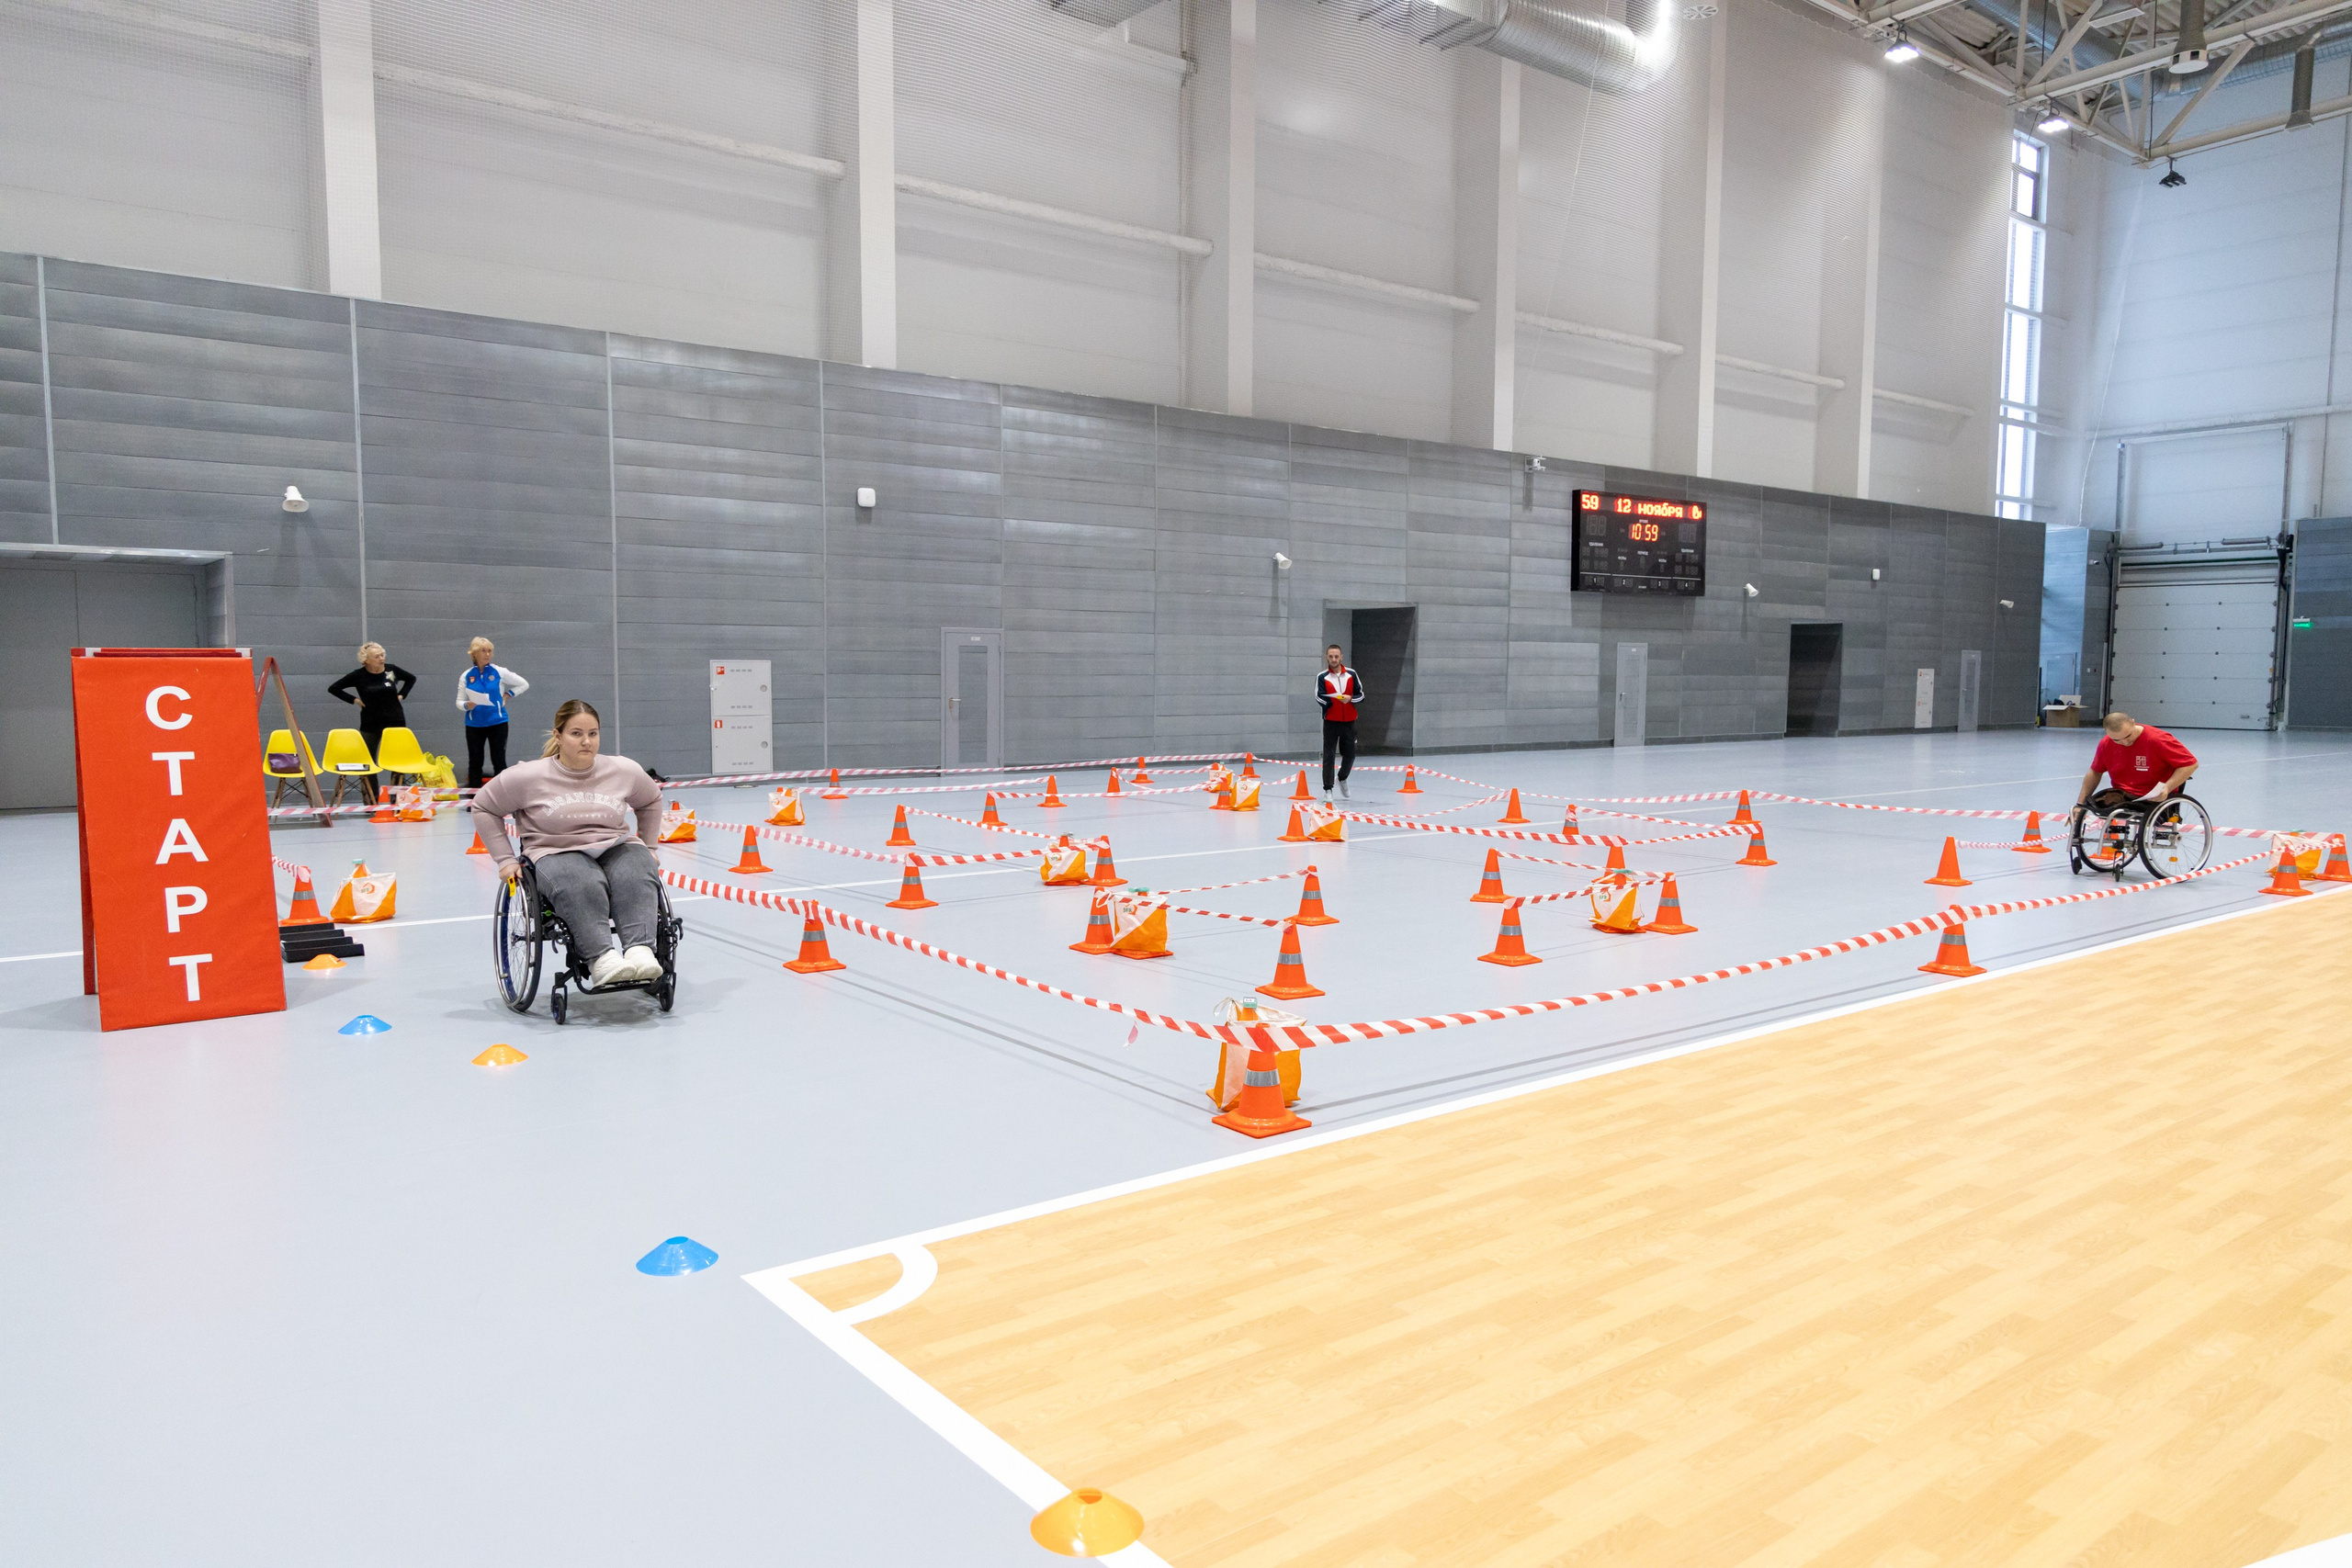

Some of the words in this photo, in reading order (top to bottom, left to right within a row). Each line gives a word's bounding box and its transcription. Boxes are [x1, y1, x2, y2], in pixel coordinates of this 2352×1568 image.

[1581, 493, 1600, 511] 59
[1617, 498, 1632, 513] 12
[145, 685, 213, 1001] СТАРТ
